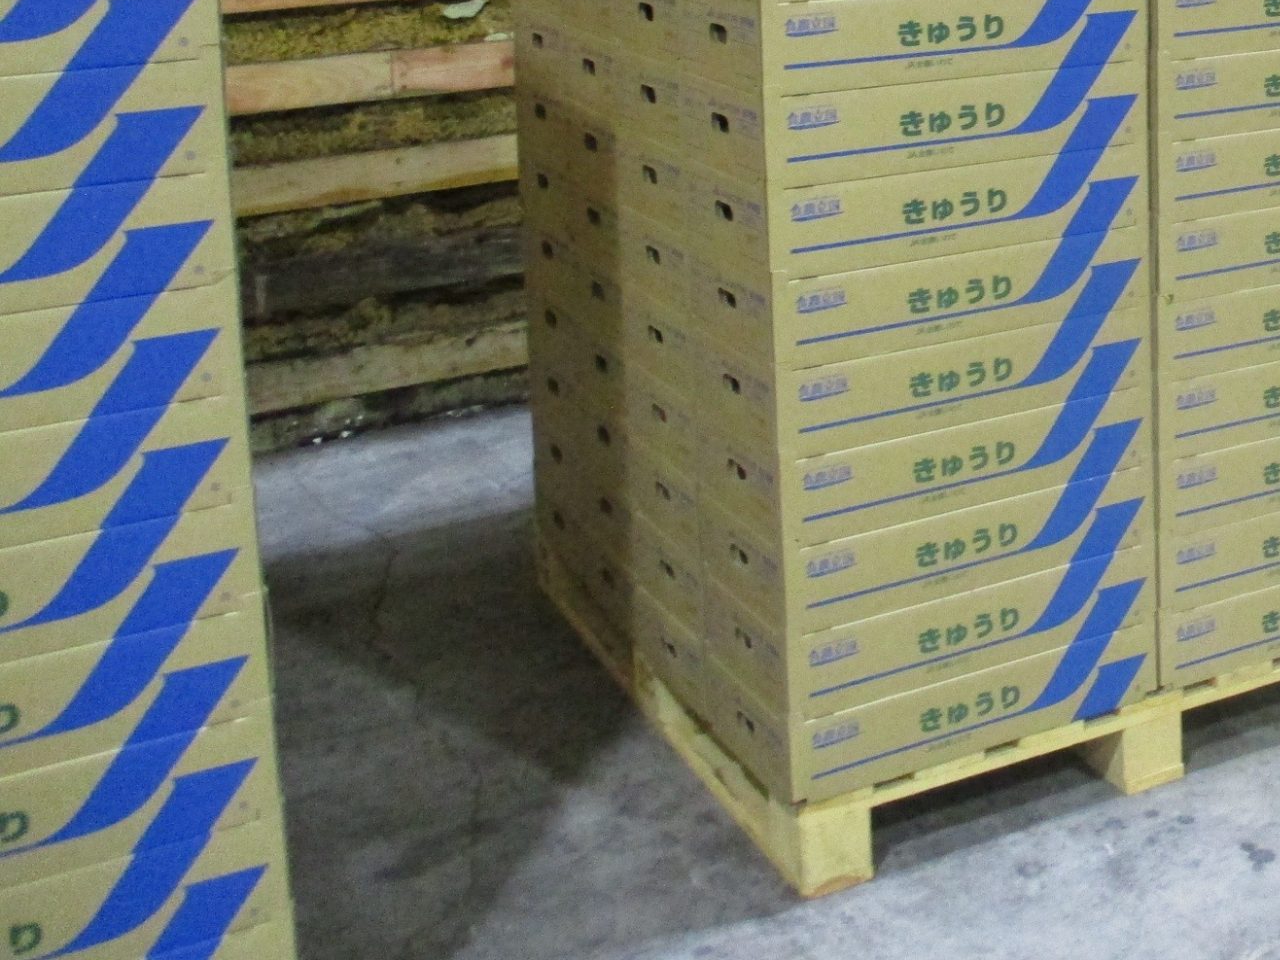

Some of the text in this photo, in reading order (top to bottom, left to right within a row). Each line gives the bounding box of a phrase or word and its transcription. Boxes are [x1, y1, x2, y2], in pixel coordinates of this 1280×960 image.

[897, 14, 1004, 47] きゅうり
[899, 100, 1004, 137] きゅうり
[902, 186, 1006, 225] きゅうり
[907, 274, 1013, 314] きゅうり
[909, 356, 1014, 398] きゅうり
[913, 440, 1017, 483] きゅうり
[917, 522, 1020, 568] きゅうり
[918, 607, 1020, 654] きゅうり
[920, 686, 1021, 733] きゅうり
